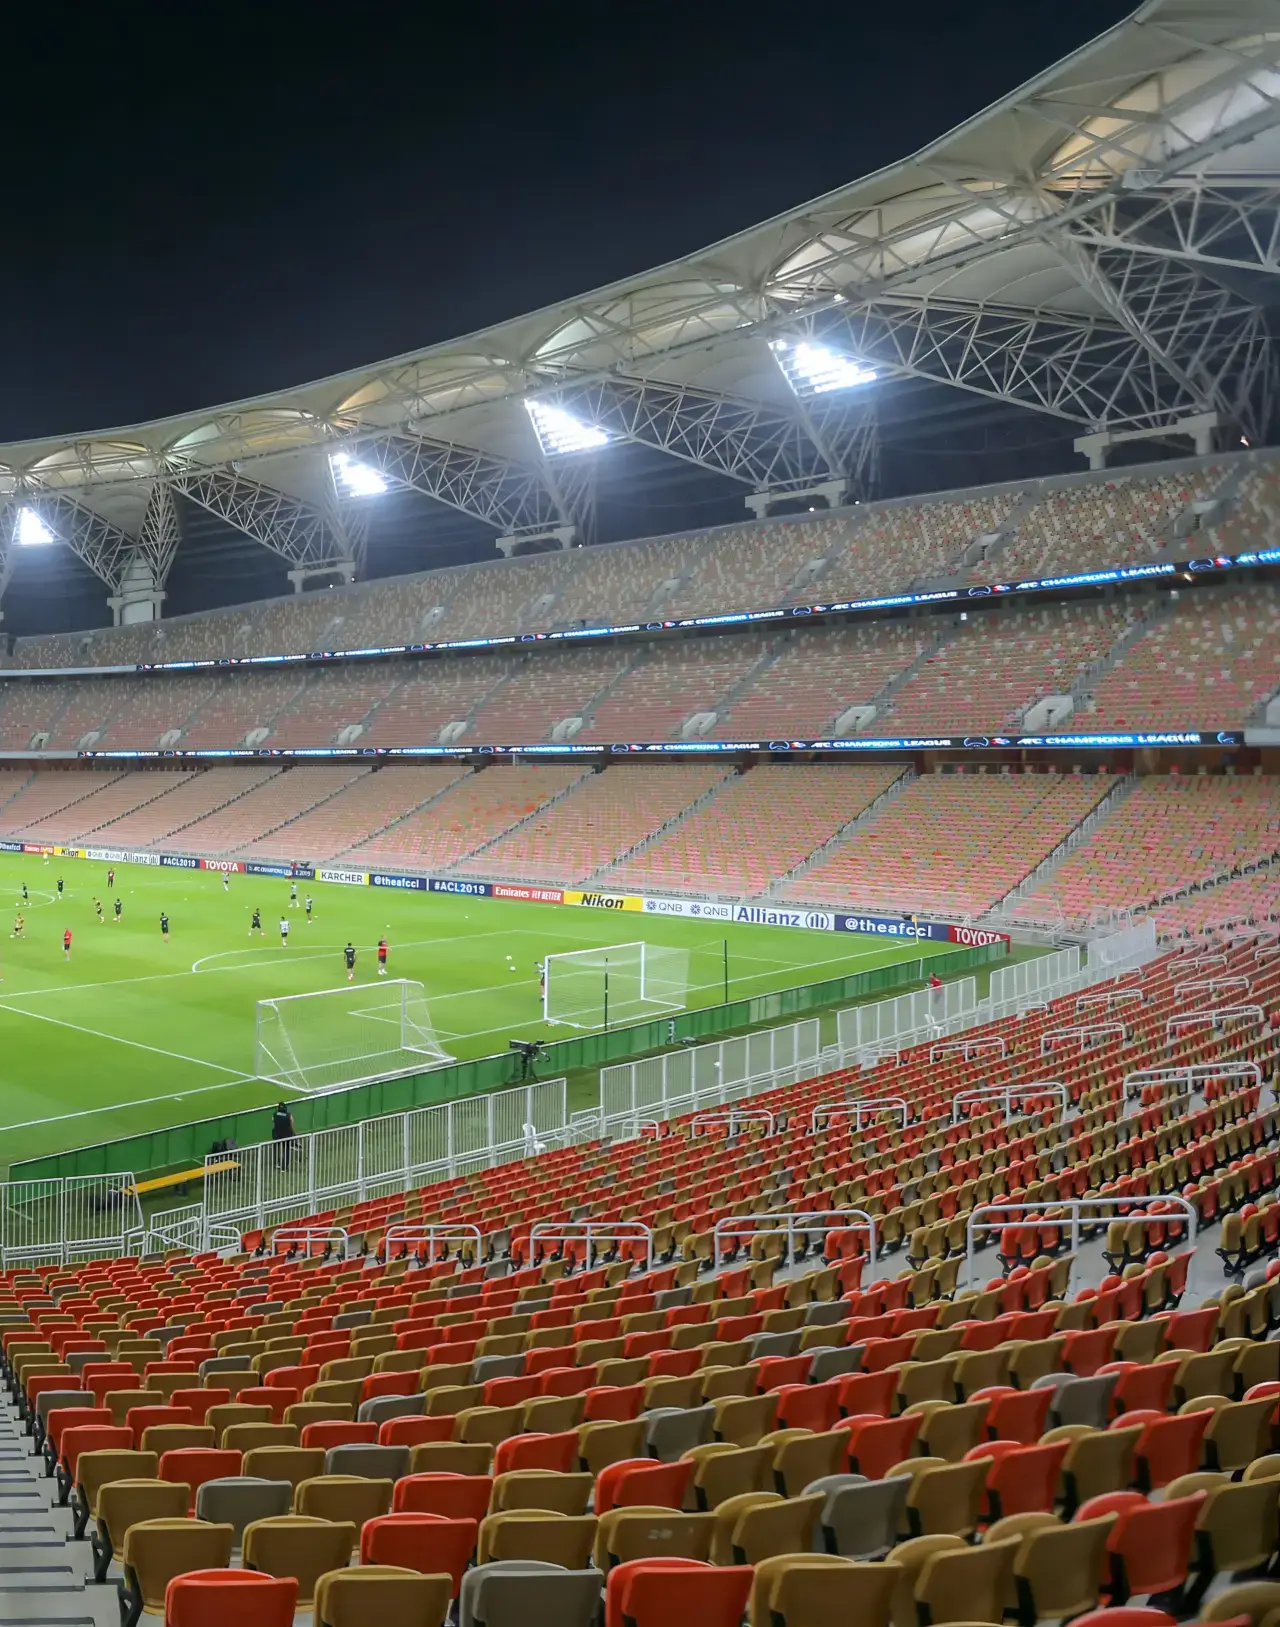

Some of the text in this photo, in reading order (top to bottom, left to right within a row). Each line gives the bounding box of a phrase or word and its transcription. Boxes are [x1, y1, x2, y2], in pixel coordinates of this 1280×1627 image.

[1040, 572, 1117, 587] CHAMPIONS
[1120, 564, 1176, 577] LEAGUE
[915, 591, 957, 601] LEAGUE
[832, 740, 900, 748] CHAMPIONS
[903, 739, 952, 747] LEAGUE
[1045, 735, 1133, 745] CHAMPIONS
[1137, 733, 1201, 745] LEAGUE
[60, 848, 80, 857] Nikon
[122, 852, 148, 864] Allianz
[163, 857, 196, 867] #ACL2019
[204, 860, 239, 872] TOYOTA
[374, 875, 419, 888] @theafccl
[434, 881, 486, 894] #ACL2019
[495, 886, 530, 898] Emirates
[541, 891, 562, 901] BETTER
[581, 893, 625, 909] Nikon
[658, 902, 683, 912] QNB
[703, 906, 729, 917] QNB
[737, 906, 801, 926] Allianz
[845, 917, 933, 938] @theafccl
[954, 927, 1001, 946] TOYOTA
